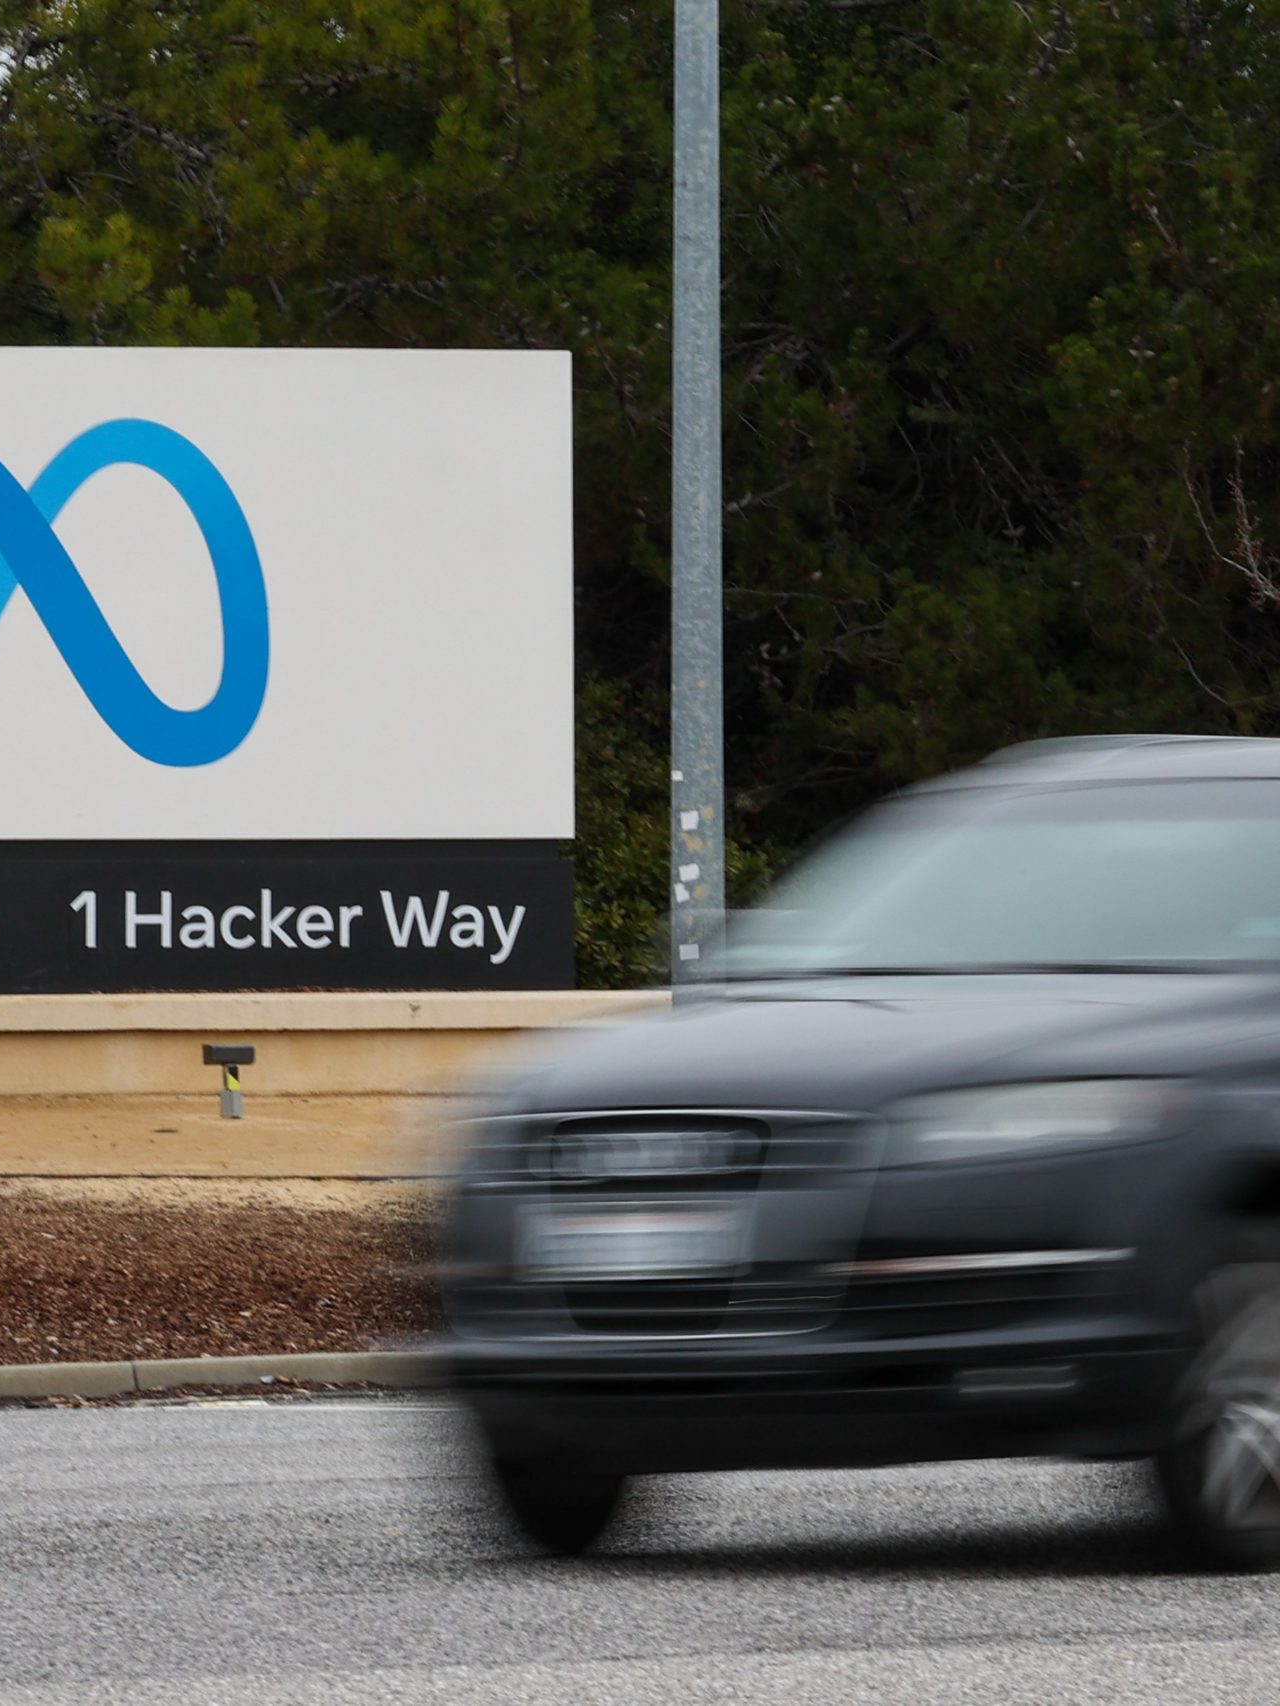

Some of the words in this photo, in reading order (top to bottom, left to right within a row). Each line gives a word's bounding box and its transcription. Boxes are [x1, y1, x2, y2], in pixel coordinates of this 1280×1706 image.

[70, 890, 96, 948] 1
[124, 888, 363, 948] Hacker
[379, 890, 526, 964] Way
